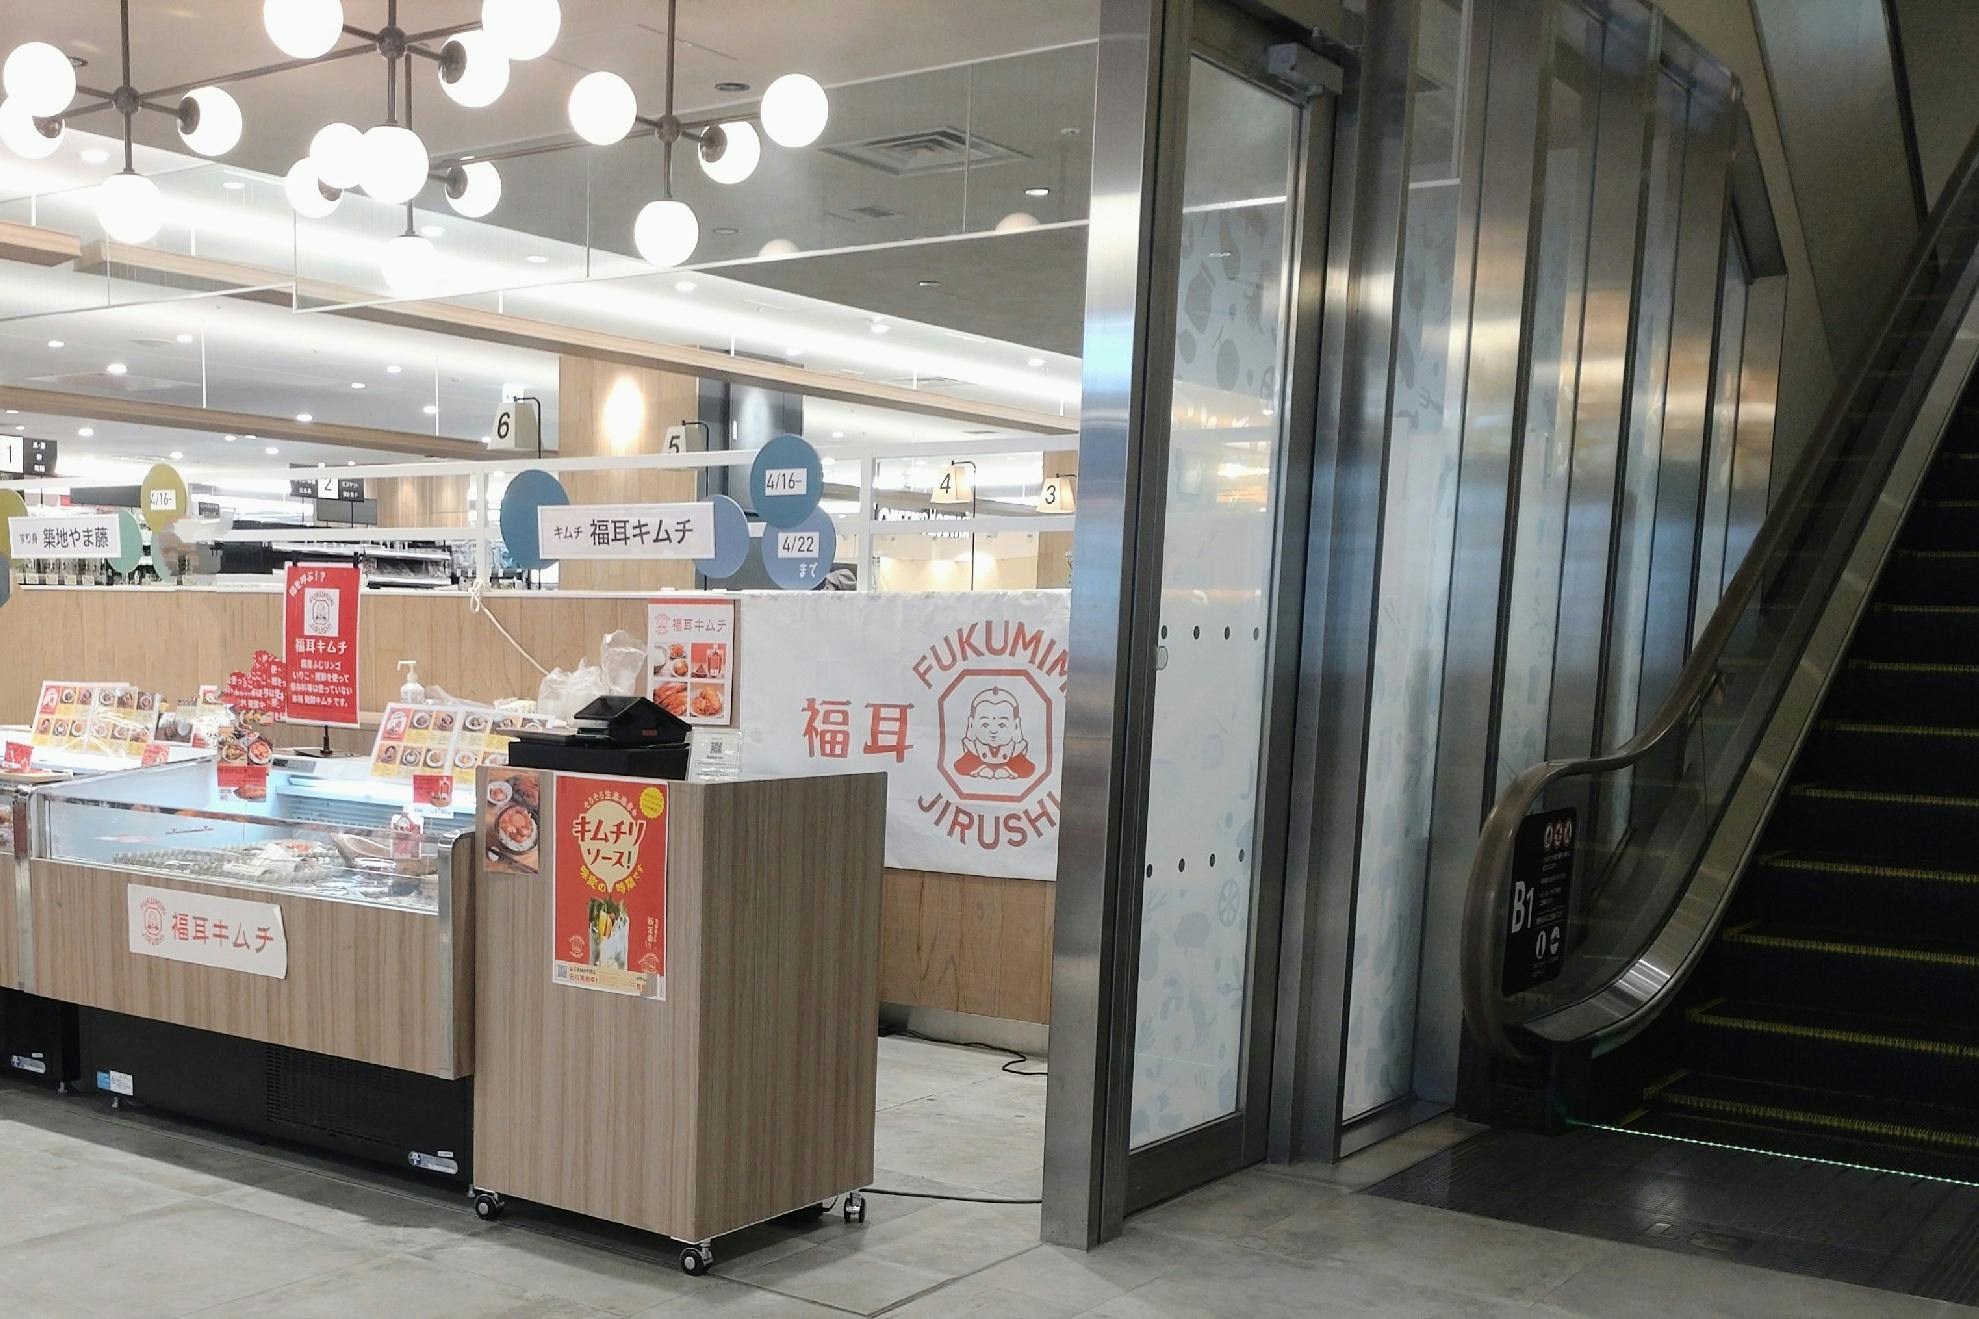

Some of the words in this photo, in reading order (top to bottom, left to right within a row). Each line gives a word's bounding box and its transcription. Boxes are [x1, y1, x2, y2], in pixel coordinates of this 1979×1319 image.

[496, 411, 511, 440] 6
[668, 434, 681, 454] 5
[939, 474, 951, 494] 4
[1045, 485, 1057, 504] 3
[43, 526, 109, 549] 築地やま藤
[553, 524, 584, 541] キムチ
[590, 518, 693, 546] 福耳キムチ
[782, 536, 815, 553] 4/22
[799, 562, 818, 579] まで
[672, 617, 727, 634] 福耳キムチ
[295, 638, 348, 655] 福耳キムチ
[574, 815, 646, 846] キムチリ
[917, 790, 1061, 850] JIRUSHI
[1511, 881, 1535, 934] B1
[170, 910, 275, 955] 福耳キムチ
